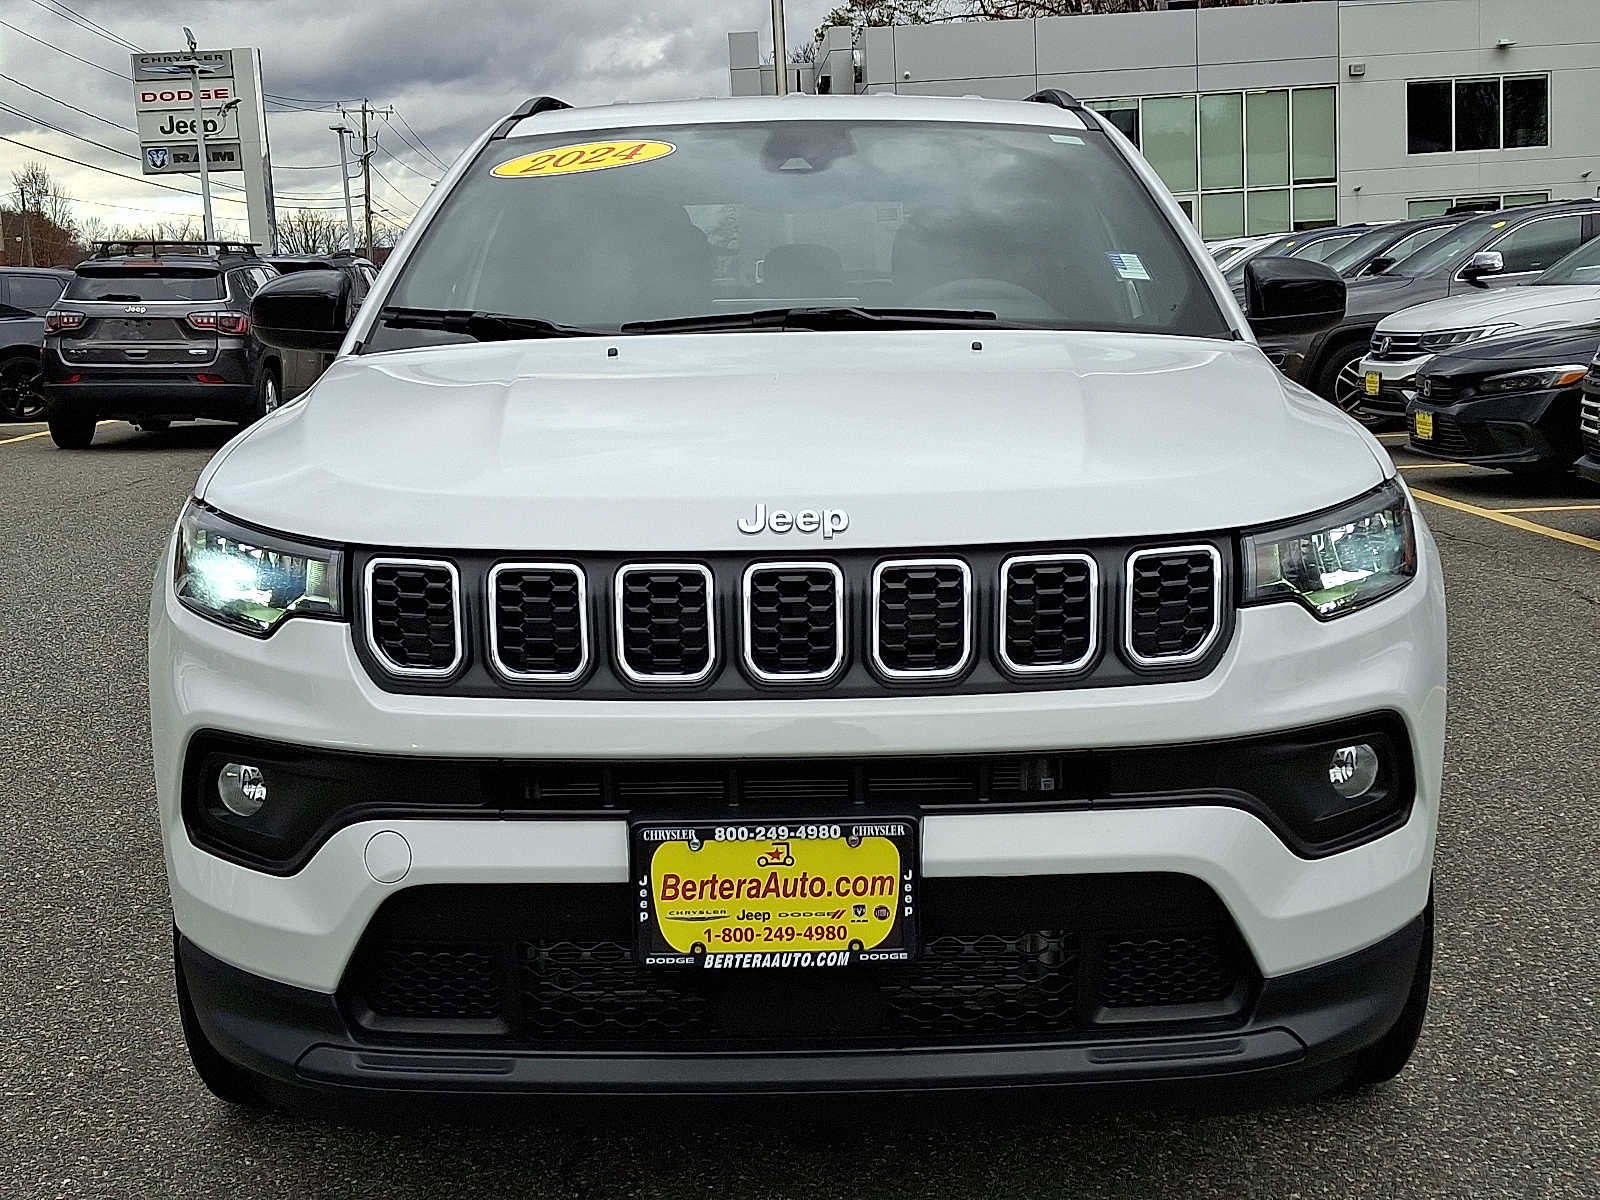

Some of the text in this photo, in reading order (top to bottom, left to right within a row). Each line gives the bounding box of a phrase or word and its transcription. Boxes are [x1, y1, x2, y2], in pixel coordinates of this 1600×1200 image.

[140, 54, 223, 63] CHRYSLER
[141, 89, 229, 102] DODGE
[520, 144, 646, 173] 2024
[124, 305, 146, 314] Jeep
[737, 503, 849, 540] Jeep
[643, 829, 696, 841] CHRYSLER
[714, 825, 841, 842] 800-249-4980
[852, 825, 905, 836] CHRYSLER
[660, 872, 895, 901] BerteraAuto.com
[903, 870, 913, 917] Jeep
[639, 875, 649, 922] Jeep
[736, 909, 771, 923] Jeep
[703, 925, 848, 943] 1-800-249-4980
[645, 957, 695, 965] DODGE
[703, 952, 850, 968] BERTERAAUTO.COM
[860, 952, 908, 961] DODGE
